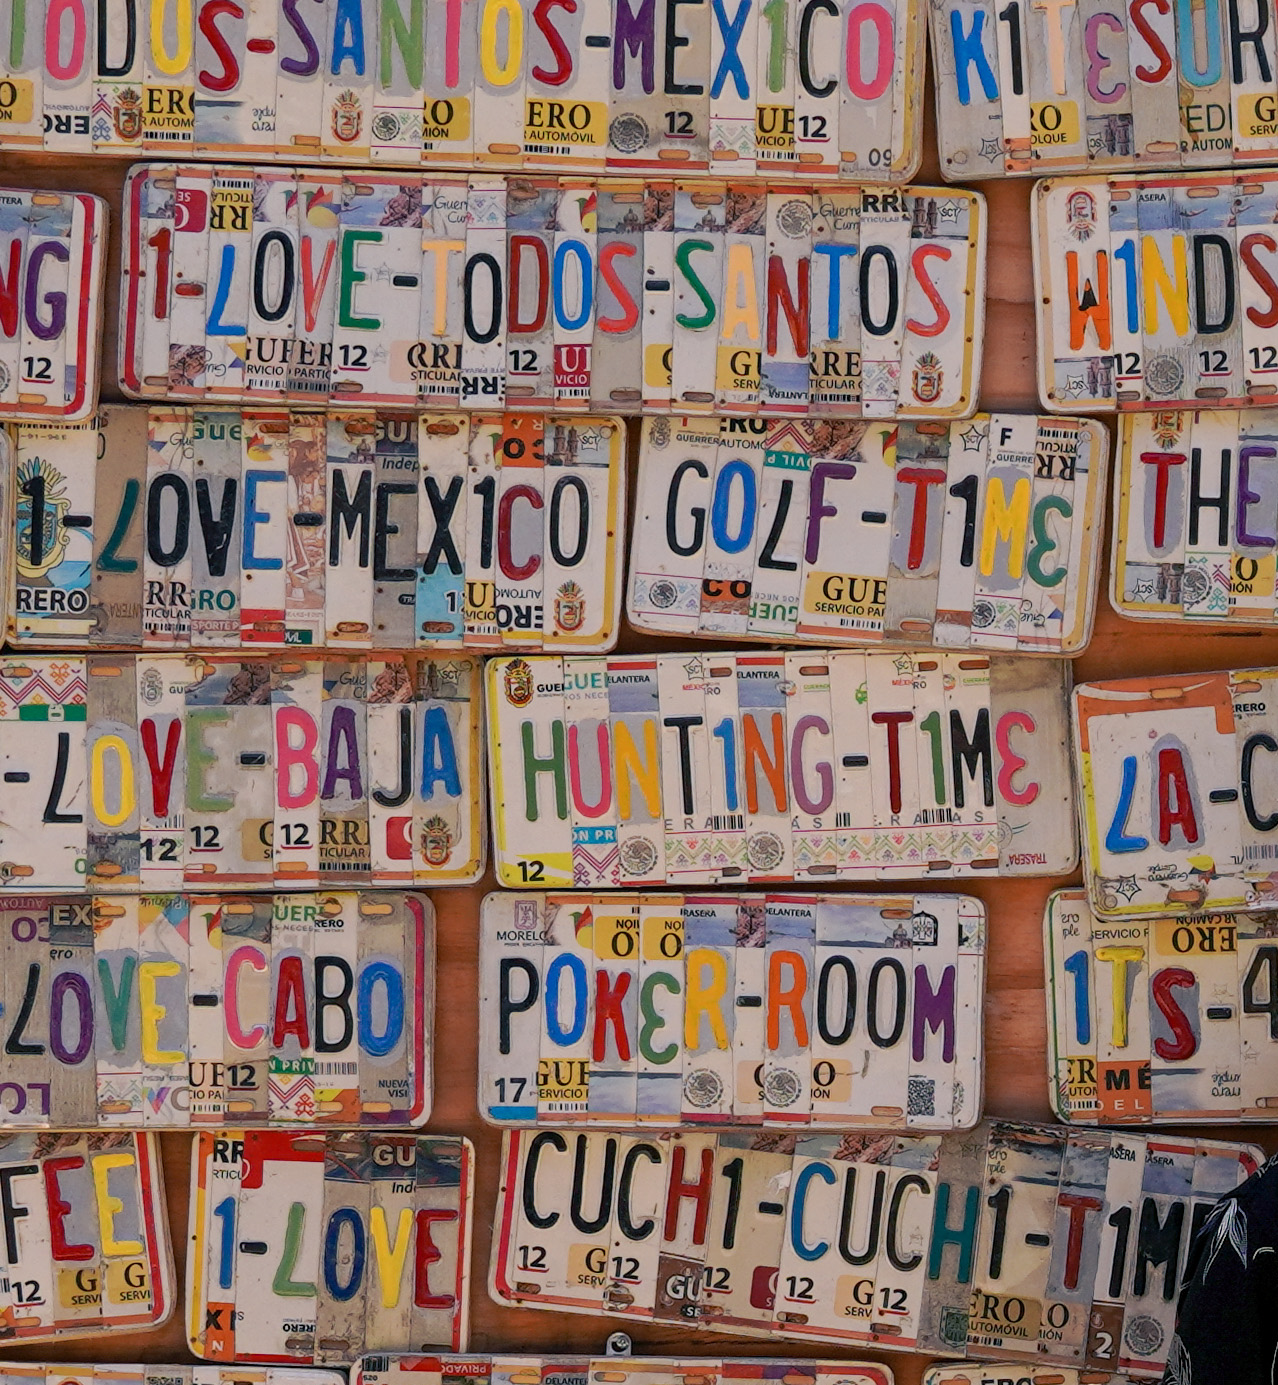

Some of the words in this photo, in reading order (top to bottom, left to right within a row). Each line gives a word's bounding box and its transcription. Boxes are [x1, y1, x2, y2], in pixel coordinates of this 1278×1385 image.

[664, 110, 694, 135] 12
[338, 344, 368, 367] 12
[1113, 352, 1142, 375] 12
[1198, 349, 1229, 373] 12
[23, 356, 52, 380] 12
[189, 825, 220, 848] 12
[139, 838, 177, 862] 12
[517, 860, 545, 883] 12
[226, 1064, 256, 1087] 12
[494, 1077, 527, 1103] 17
[518, 1245, 547, 1271] 12
[11, 1279, 42, 1303] 12
[786, 1275, 814, 1300] 12
